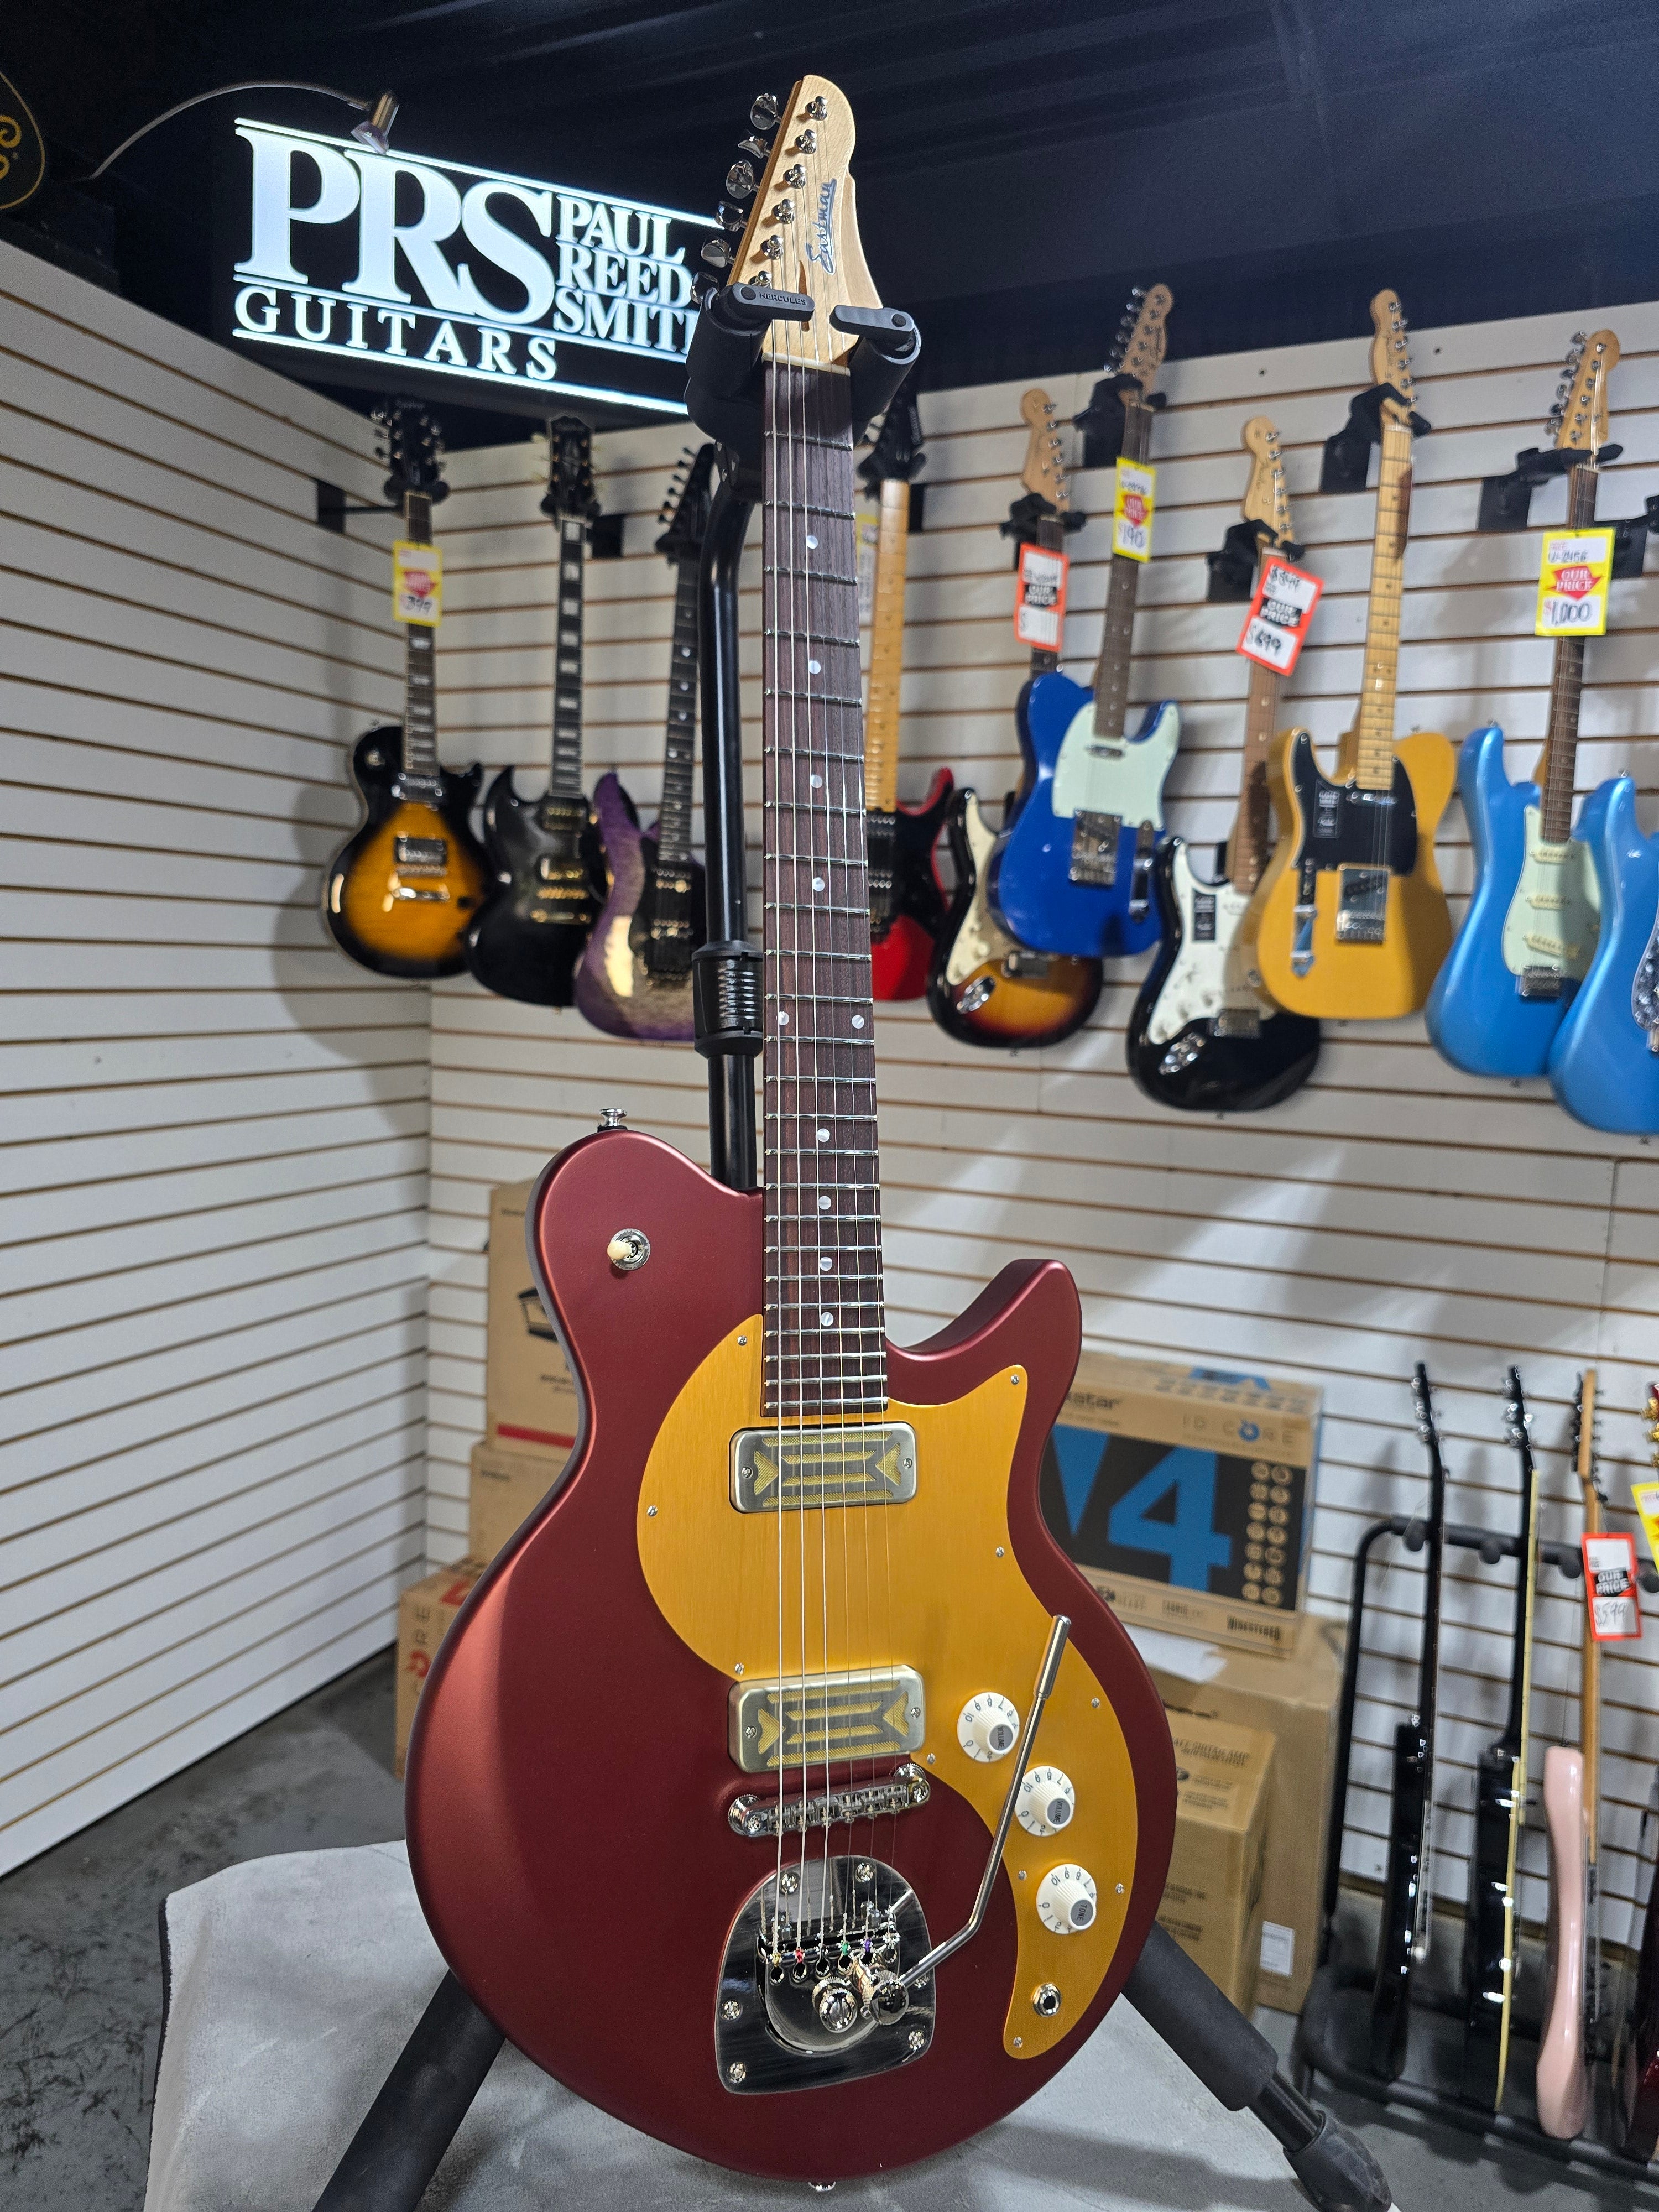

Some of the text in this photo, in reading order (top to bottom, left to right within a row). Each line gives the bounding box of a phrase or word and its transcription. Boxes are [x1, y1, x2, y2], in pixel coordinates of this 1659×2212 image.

[233, 127, 556, 325] PRS
[555, 195, 686, 265] PAUL
[806, 178, 837, 274] Eastman
[555, 241, 693, 309] REED
[758, 292, 806, 306] HERCULES
[233, 285, 557, 382] GUITARS
[1561, 568, 1589, 580] OUR
[1556, 580, 1593, 592] PRICE
[1260, 607, 1300, 627] PRICE
[1267, 599, 1297, 616] OUR
[1595, 1577, 1631, 1595] PRICE
[1598, 1569, 1625, 1584] OUR
[1053, 1800, 1063, 1823] VOLUME
[1077, 1903, 1087, 1921] TONE
